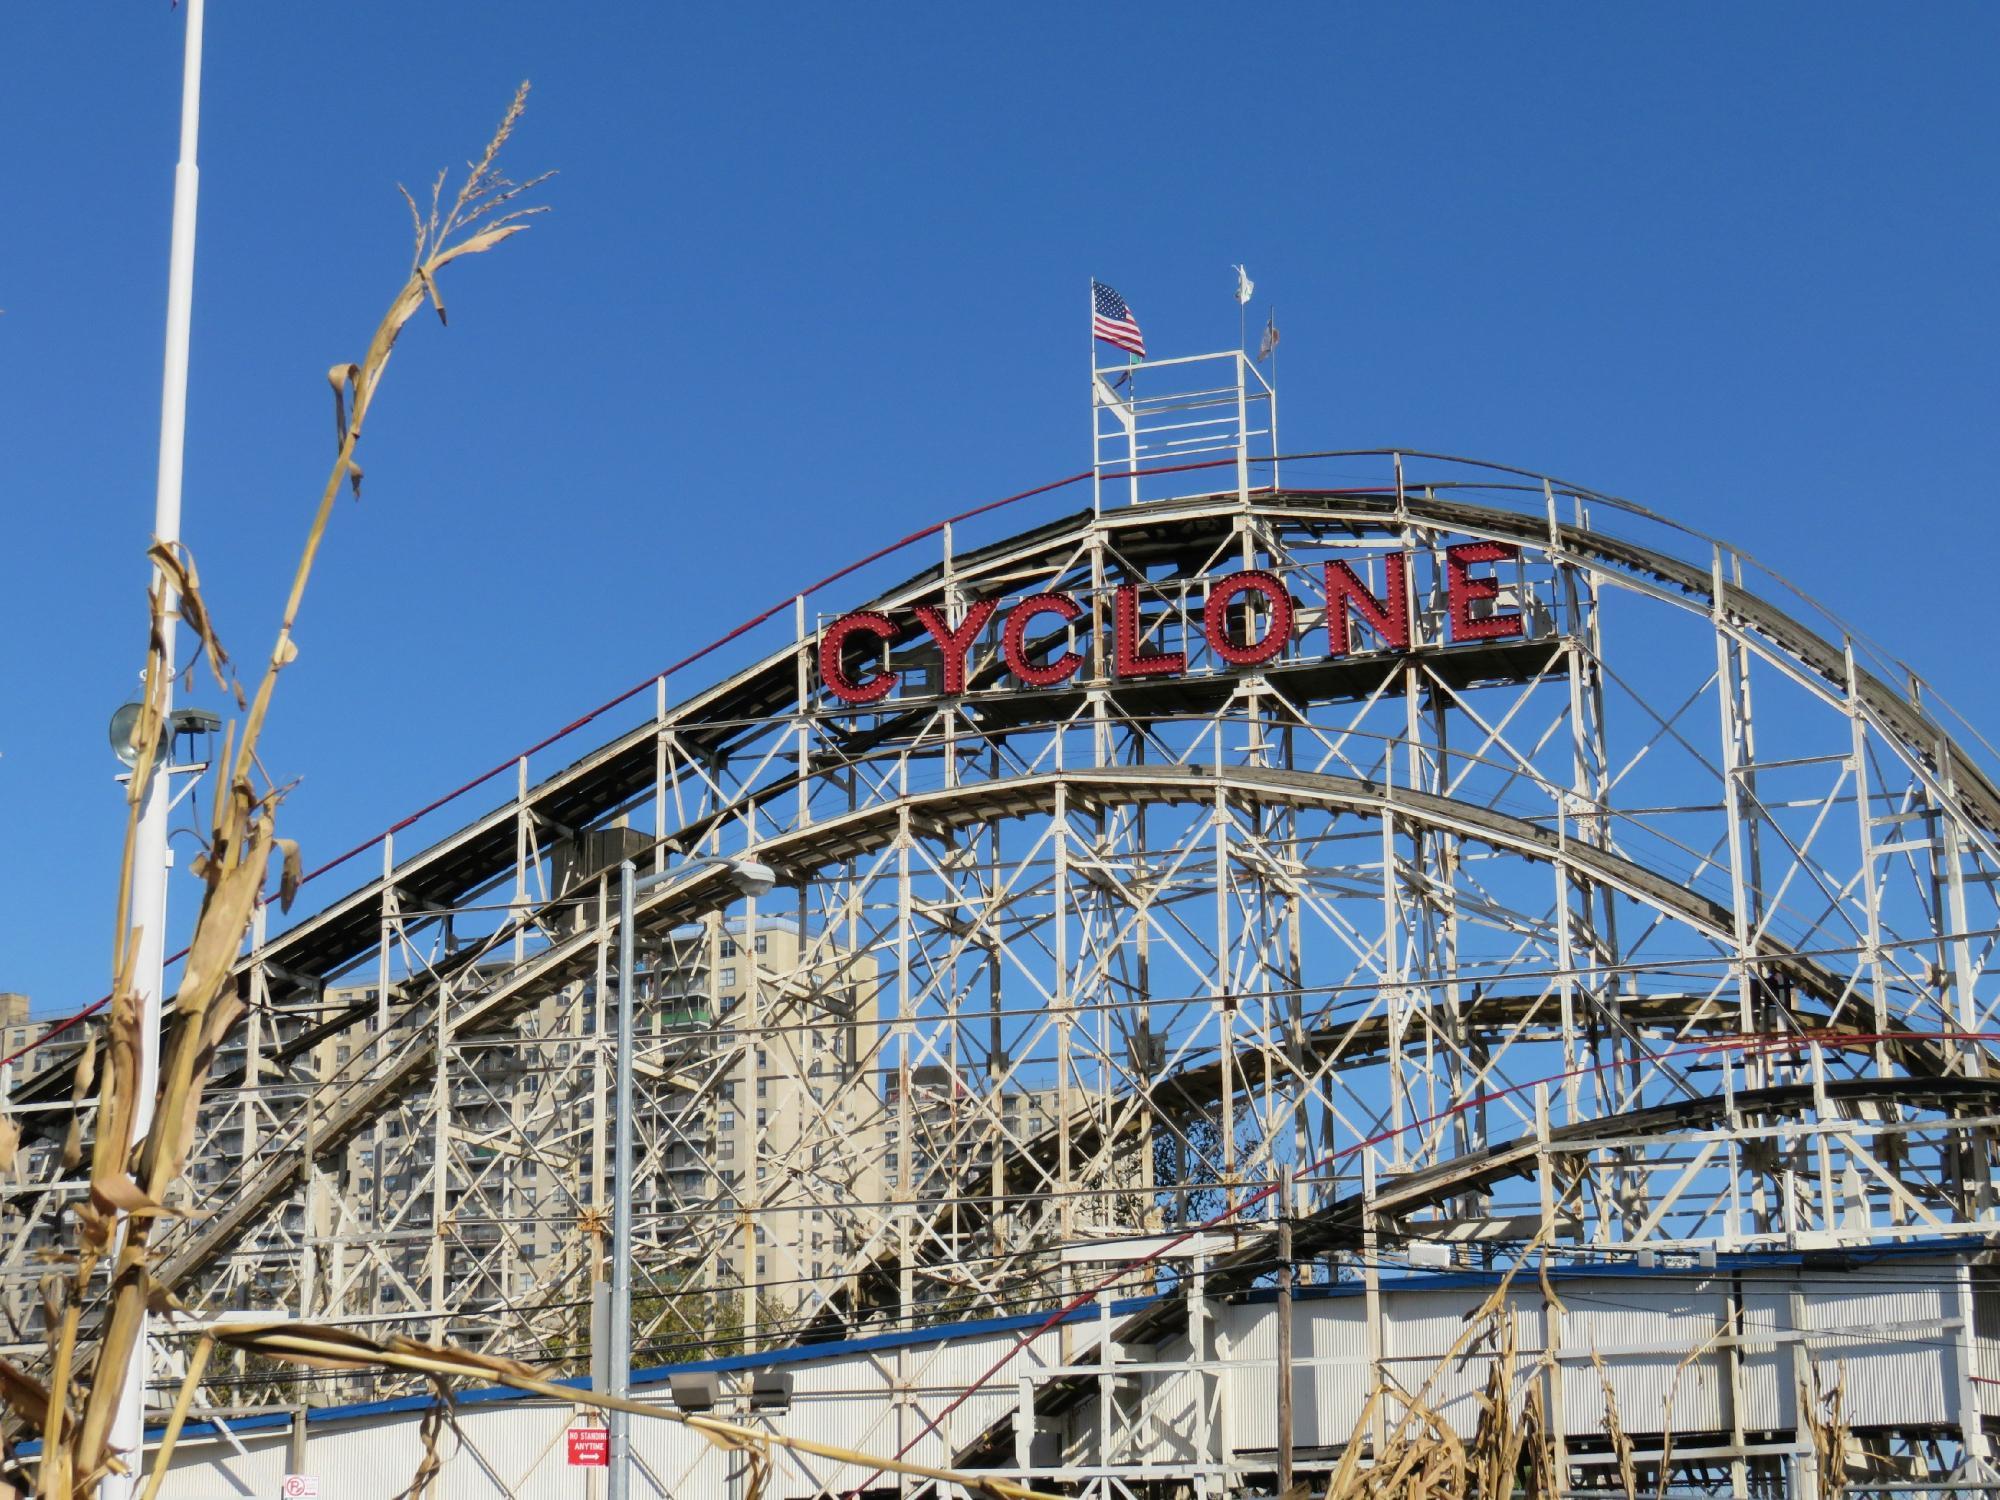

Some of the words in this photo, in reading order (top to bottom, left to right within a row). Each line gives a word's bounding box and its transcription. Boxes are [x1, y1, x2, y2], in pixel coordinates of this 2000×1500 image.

[818, 541, 1525, 703] CYCLONE
[569, 1432, 579, 1440] NO
[574, 1442, 605, 1451] ANYTIME
